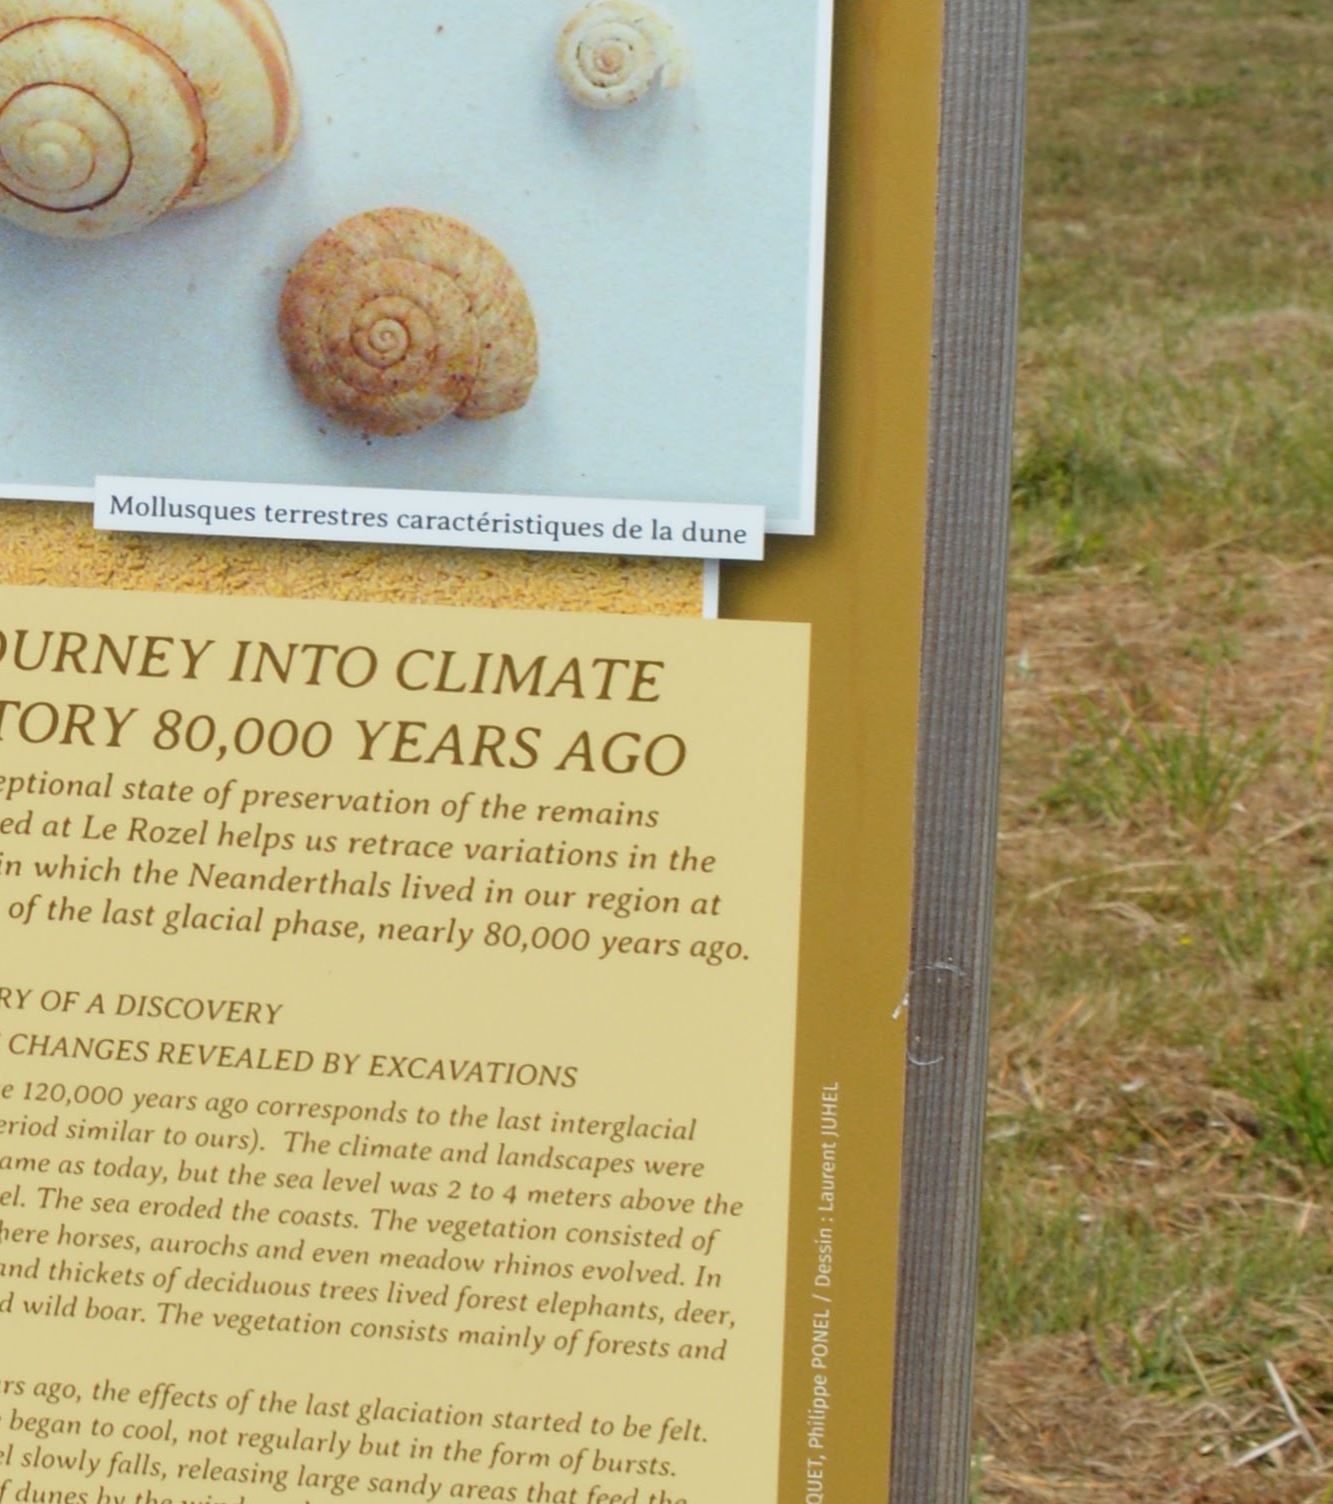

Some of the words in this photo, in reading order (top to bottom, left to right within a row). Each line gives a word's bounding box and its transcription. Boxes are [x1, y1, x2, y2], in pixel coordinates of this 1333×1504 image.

[110, 495, 256, 526] Mollusques
[265, 505, 388, 528] terrestres
[397, 512, 604, 542] caractéristiques
[612, 517, 642, 539] de
[652, 518, 673, 541] la
[682, 520, 747, 544] dune
[228, 640, 378, 688] INTO
[396, 649, 665, 702] CLIMATE
[153, 709, 332, 761] 80,000
[356, 720, 541, 769] YEARS
[554, 730, 686, 776] AGO
[40, 990, 80, 1012] OF
[85, 993, 105, 1014] A
[115, 994, 283, 1025] DISCOVERY
[821, 1082, 839, 1137] JUHEL
[818, 1142, 836, 1211] Laurent
[814, 1228, 832, 1287] Dessin
[811, 1309, 830, 1369] PONEL
[807, 1374, 830, 1448] Philippe
